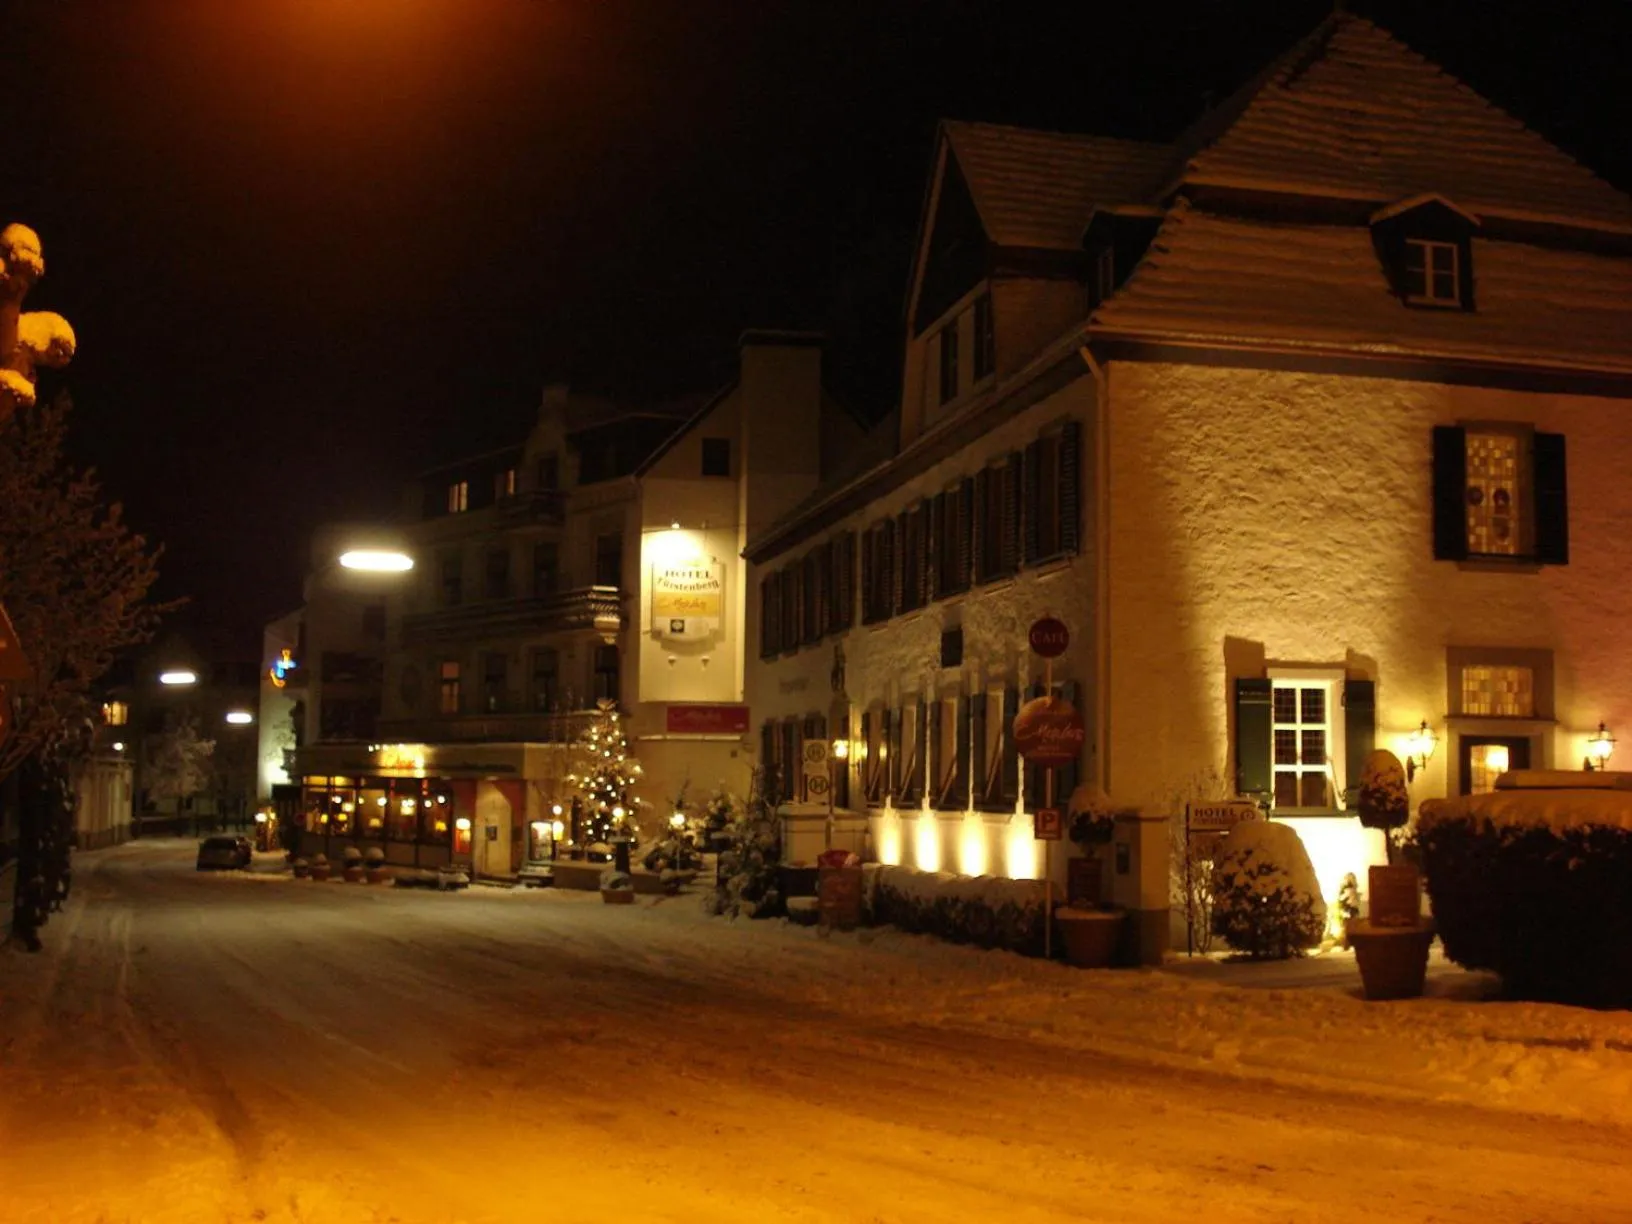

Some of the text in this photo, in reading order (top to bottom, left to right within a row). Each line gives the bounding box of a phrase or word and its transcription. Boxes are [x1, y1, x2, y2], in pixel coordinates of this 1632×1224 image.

[665, 569, 713, 579] HOTEL
[1194, 807, 1237, 817] HOTEL
[1042, 814, 1054, 829] P
